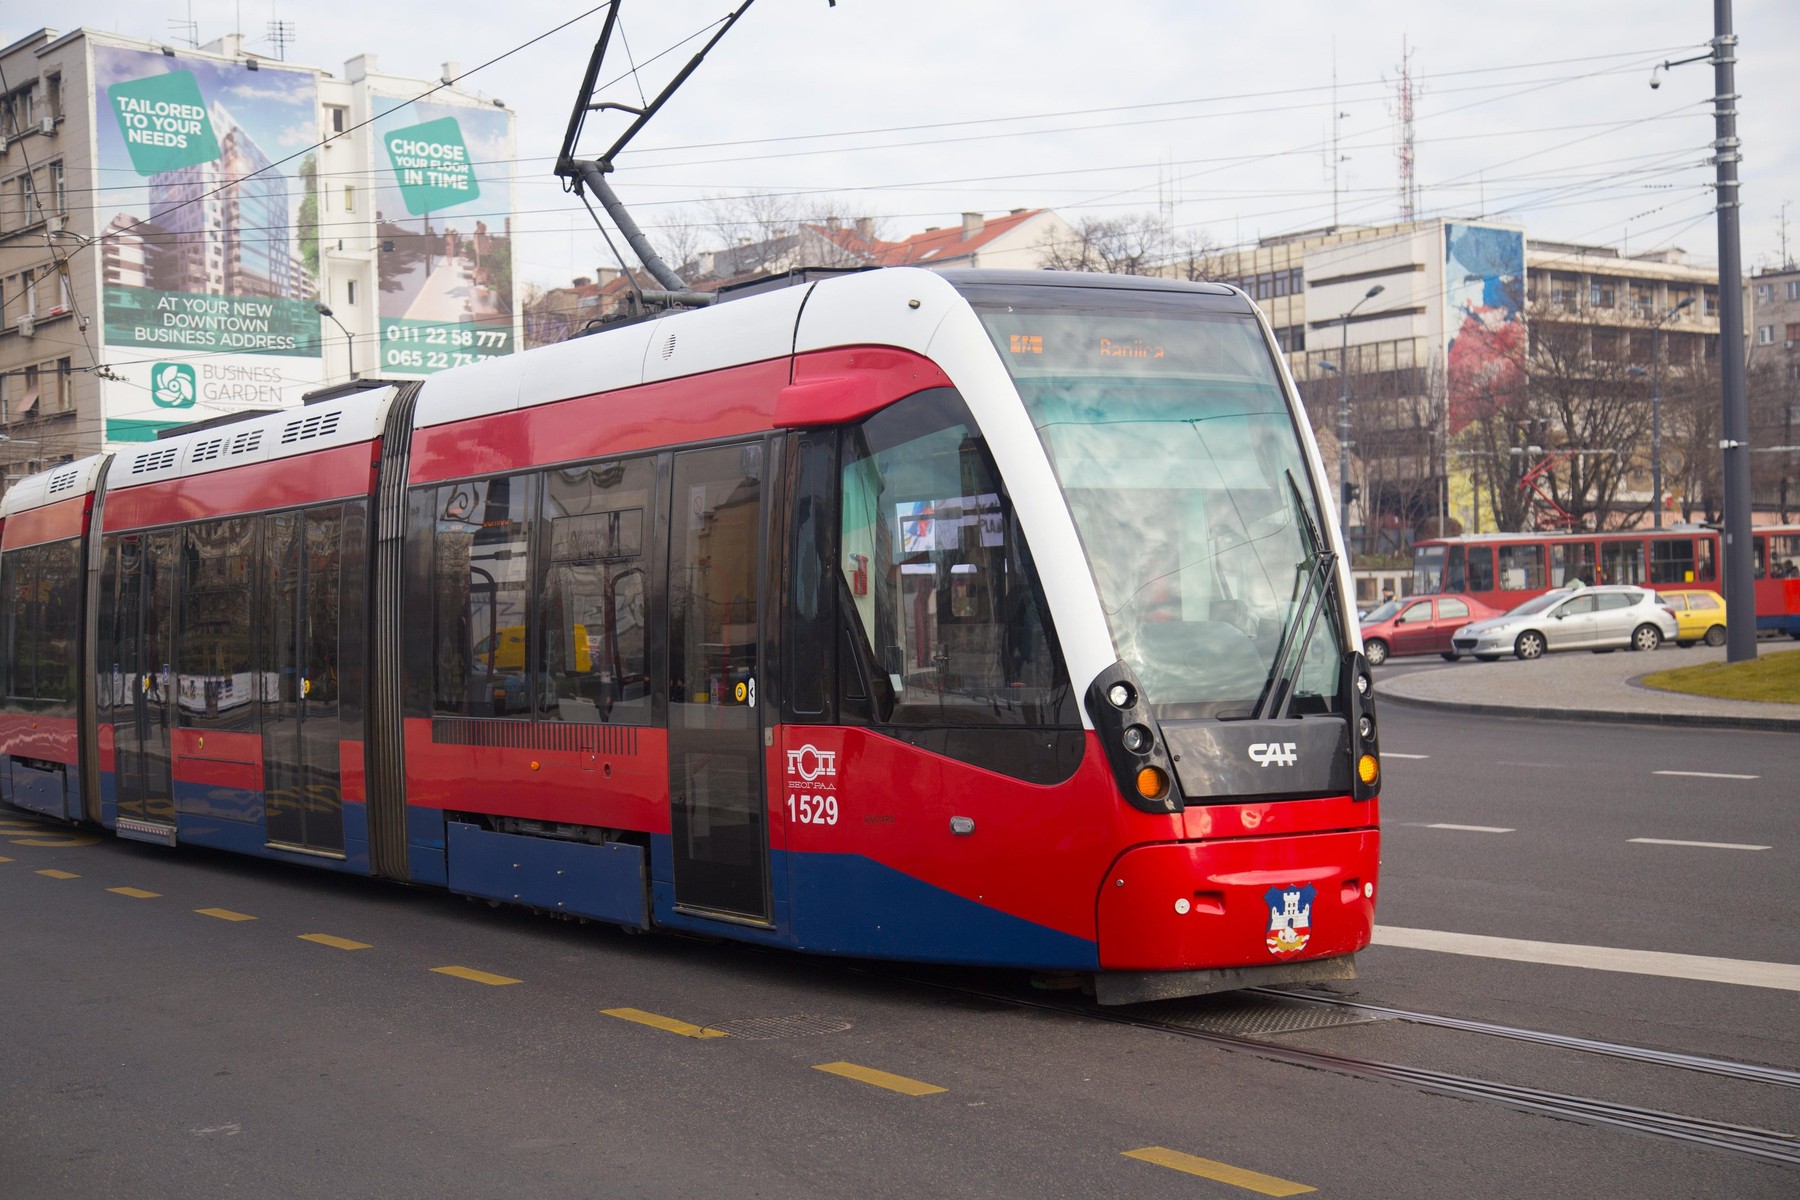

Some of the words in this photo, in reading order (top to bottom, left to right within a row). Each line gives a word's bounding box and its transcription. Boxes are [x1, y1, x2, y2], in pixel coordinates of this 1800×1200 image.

[117, 96, 205, 120] TAILORED
[122, 112, 148, 128] TO
[152, 116, 202, 135] YOUR
[128, 128, 188, 148] NEEDS
[390, 138, 464, 161] CHOOSE
[395, 156, 428, 168] YOUR
[430, 160, 469, 173] FLOOR
[404, 169, 423, 185] IN
[427, 171, 469, 190] TIME
[157, 297, 178, 311] AT
[182, 298, 229, 315] YOUR
[234, 302, 273, 318] NEW
[163, 313, 268, 333] DOWNTOWN
[135, 327, 216, 345] BUSINESS
[220, 332, 296, 350] ADDRESS
[386, 325, 420, 343] 011
[425, 327, 448, 345] 22
[451, 330, 473, 346] 58
[476, 331, 507, 348] 777
[387, 349, 423, 367] 065
[426, 351, 449, 368] 22
[203, 364, 282, 383] BUSINESS
[203, 382, 283, 403] GARDEN
[1248, 742, 1298, 767] CAF
[787, 781, 837, 791] БЕОГРАД
[787, 793, 839, 825] 1529
